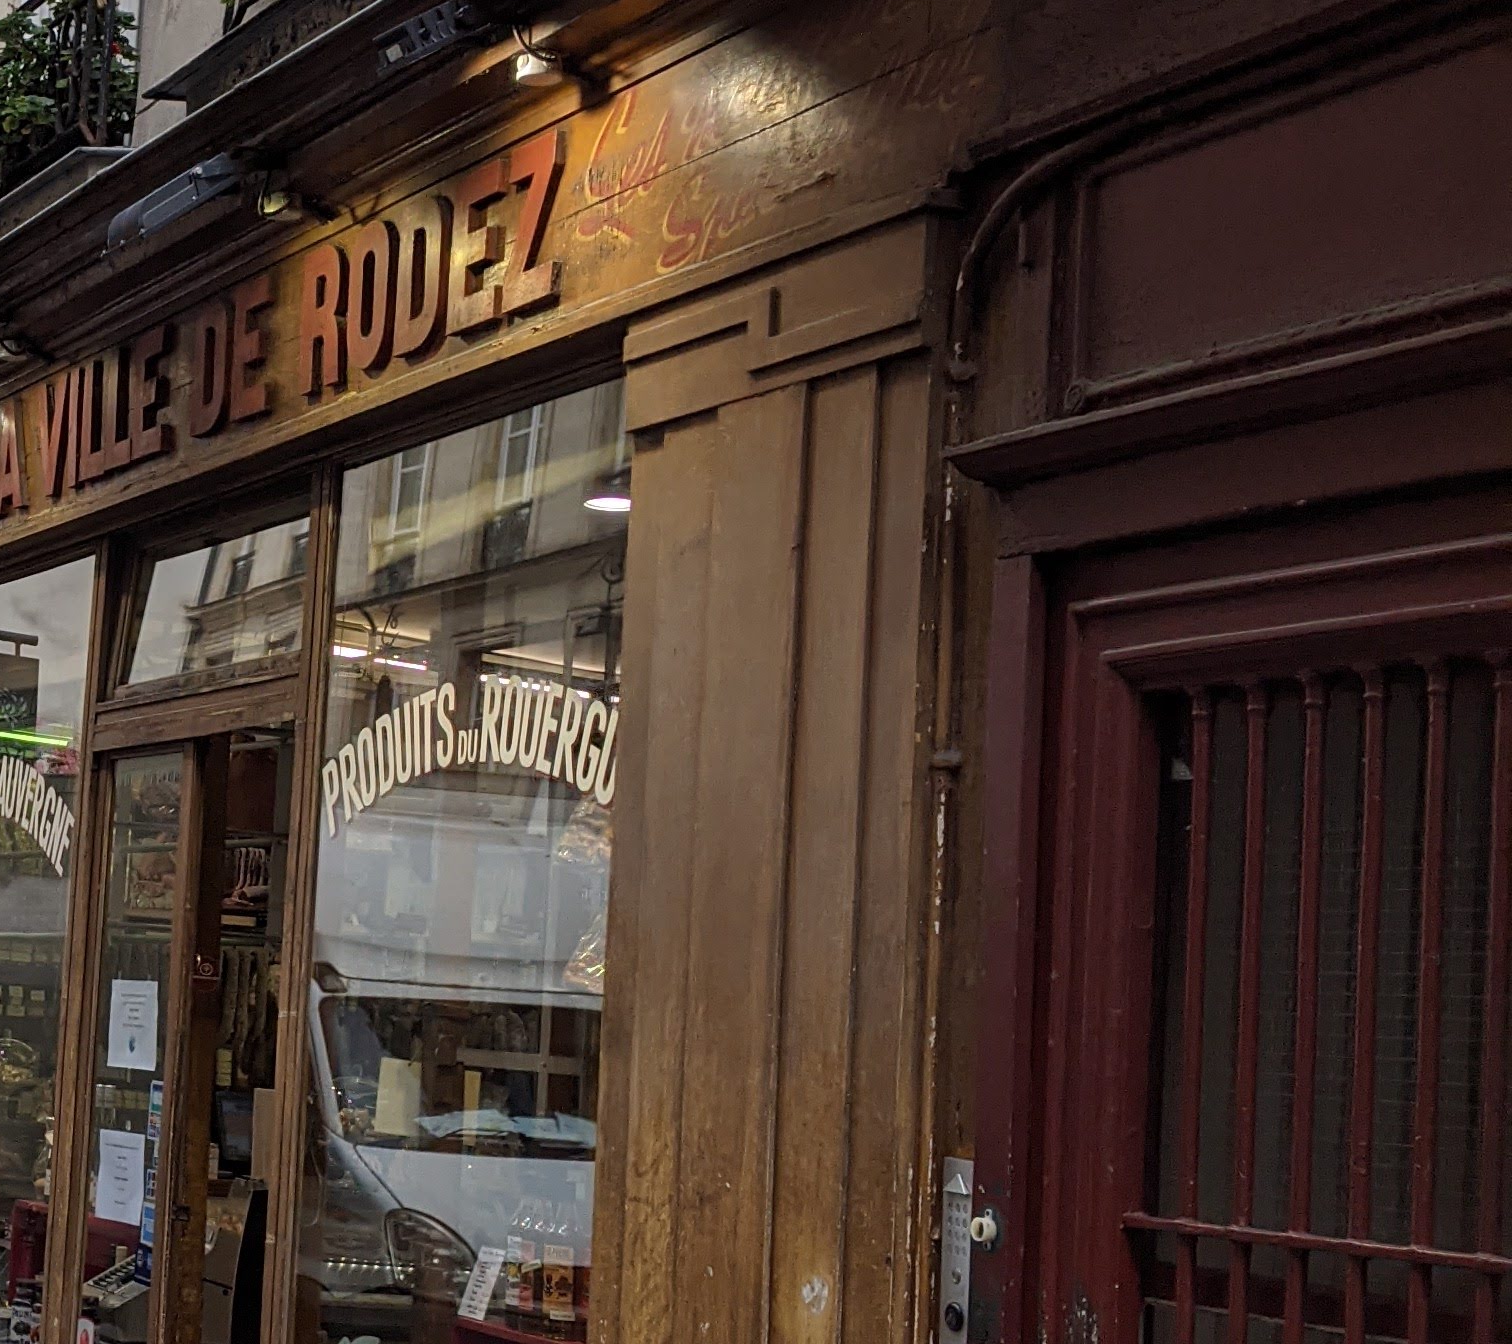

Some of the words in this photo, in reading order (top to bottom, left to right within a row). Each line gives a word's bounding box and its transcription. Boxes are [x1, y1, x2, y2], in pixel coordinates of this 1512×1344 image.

[41, 324, 173, 498] VILLE
[190, 274, 272, 438] DE
[301, 128, 564, 400] RODEZ
[321, 681, 455, 838] PRODUITS
[457, 728, 479, 765] DU
